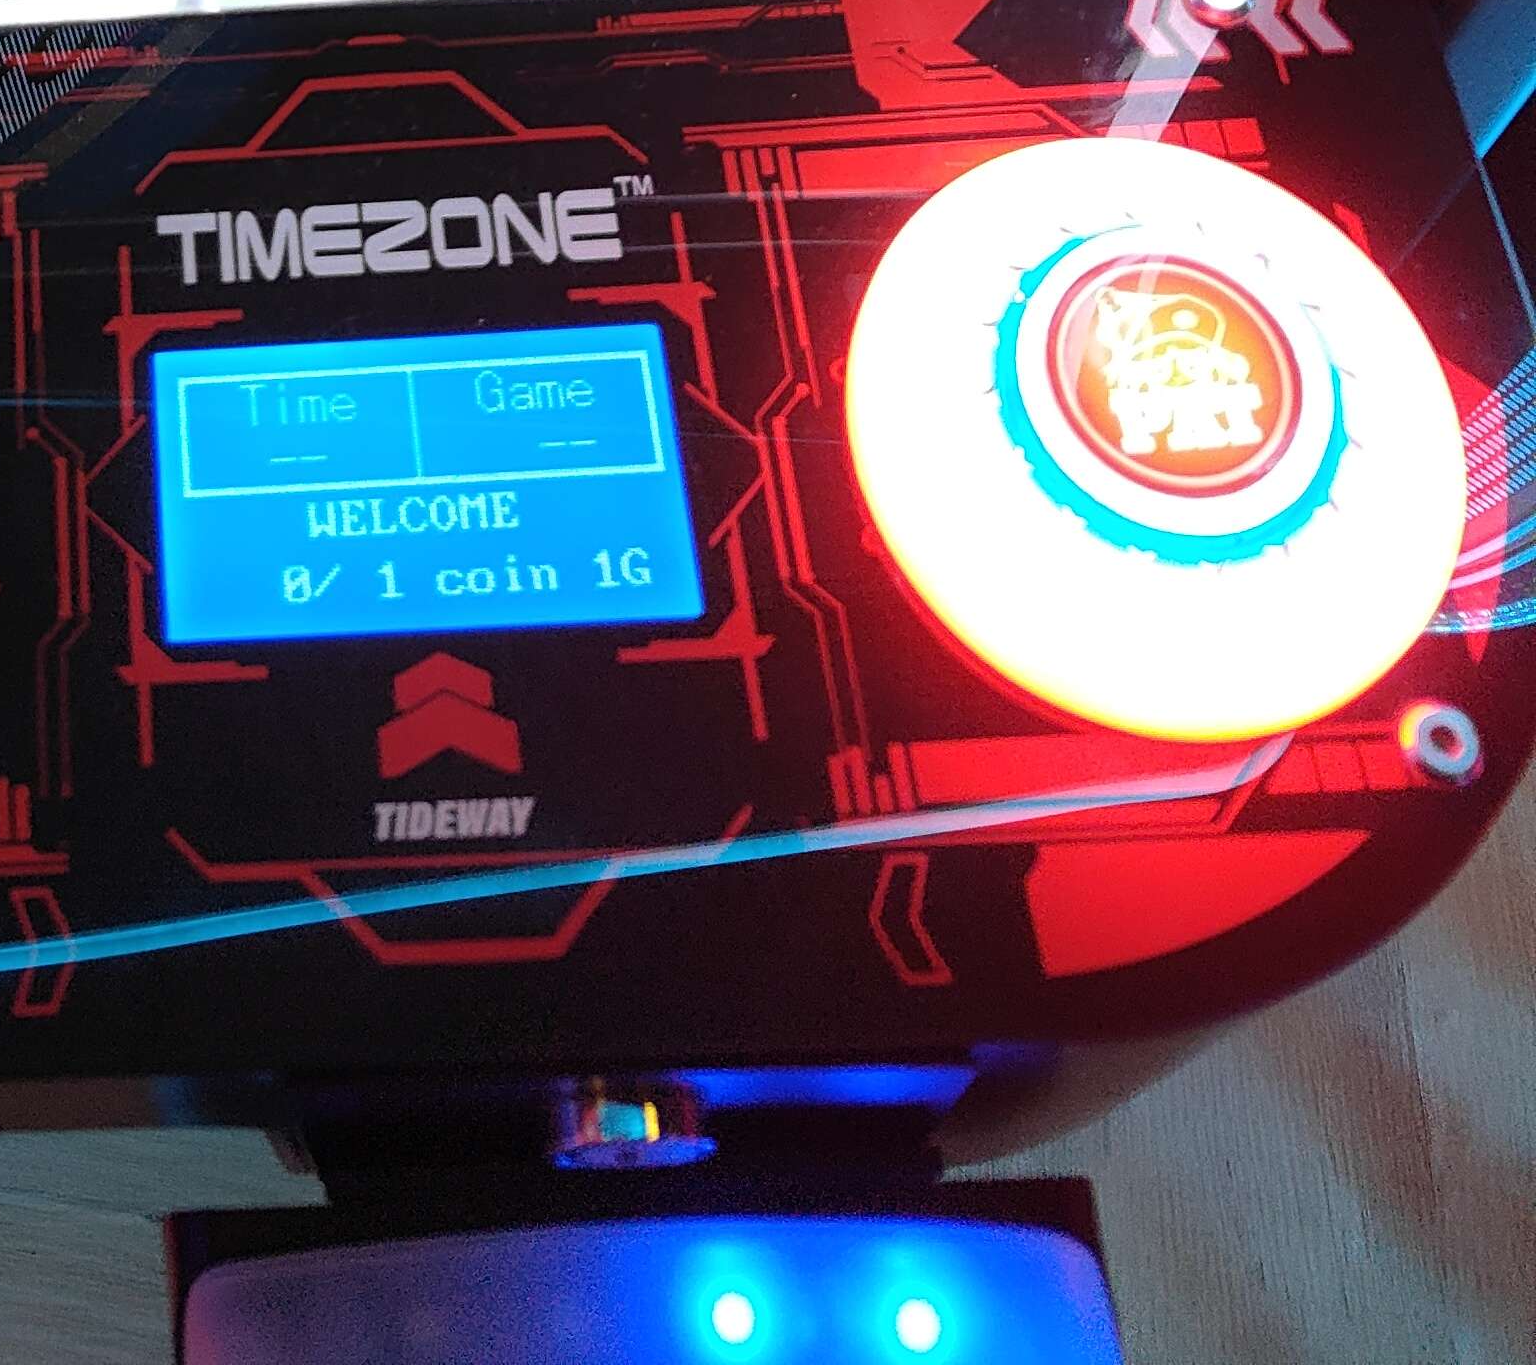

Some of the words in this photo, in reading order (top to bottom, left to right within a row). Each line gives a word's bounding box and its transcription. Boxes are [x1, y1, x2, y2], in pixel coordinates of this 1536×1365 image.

[156, 187, 624, 285] TIMEZONE
[239, 382, 358, 427] Time
[474, 368, 596, 414] Game
[305, 490, 520, 539] WELCOME
[377, 560, 406, 599] 1
[435, 553, 559, 596] coin
[592, 545, 653, 589] 1G
[373, 796, 537, 843] TIDEWAY
